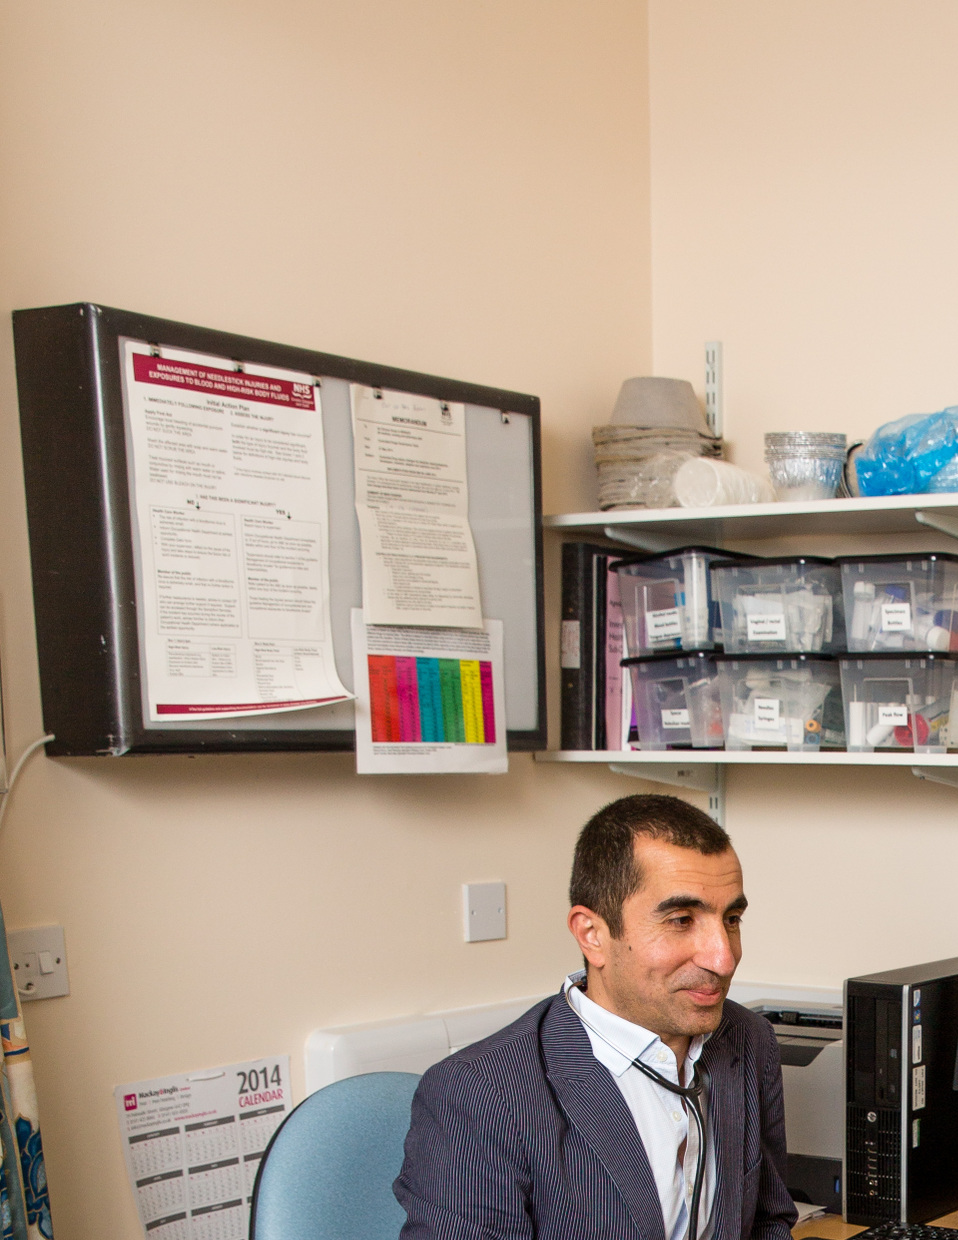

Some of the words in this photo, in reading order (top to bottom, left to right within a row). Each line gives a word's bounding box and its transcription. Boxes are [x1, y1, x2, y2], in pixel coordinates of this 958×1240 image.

[157, 363, 198, 377] MANAGEMENT
[293, 382, 311, 395] NHS
[236, 1064, 282, 1095] 2014
[238, 1088, 284, 1108] CALENDAR
